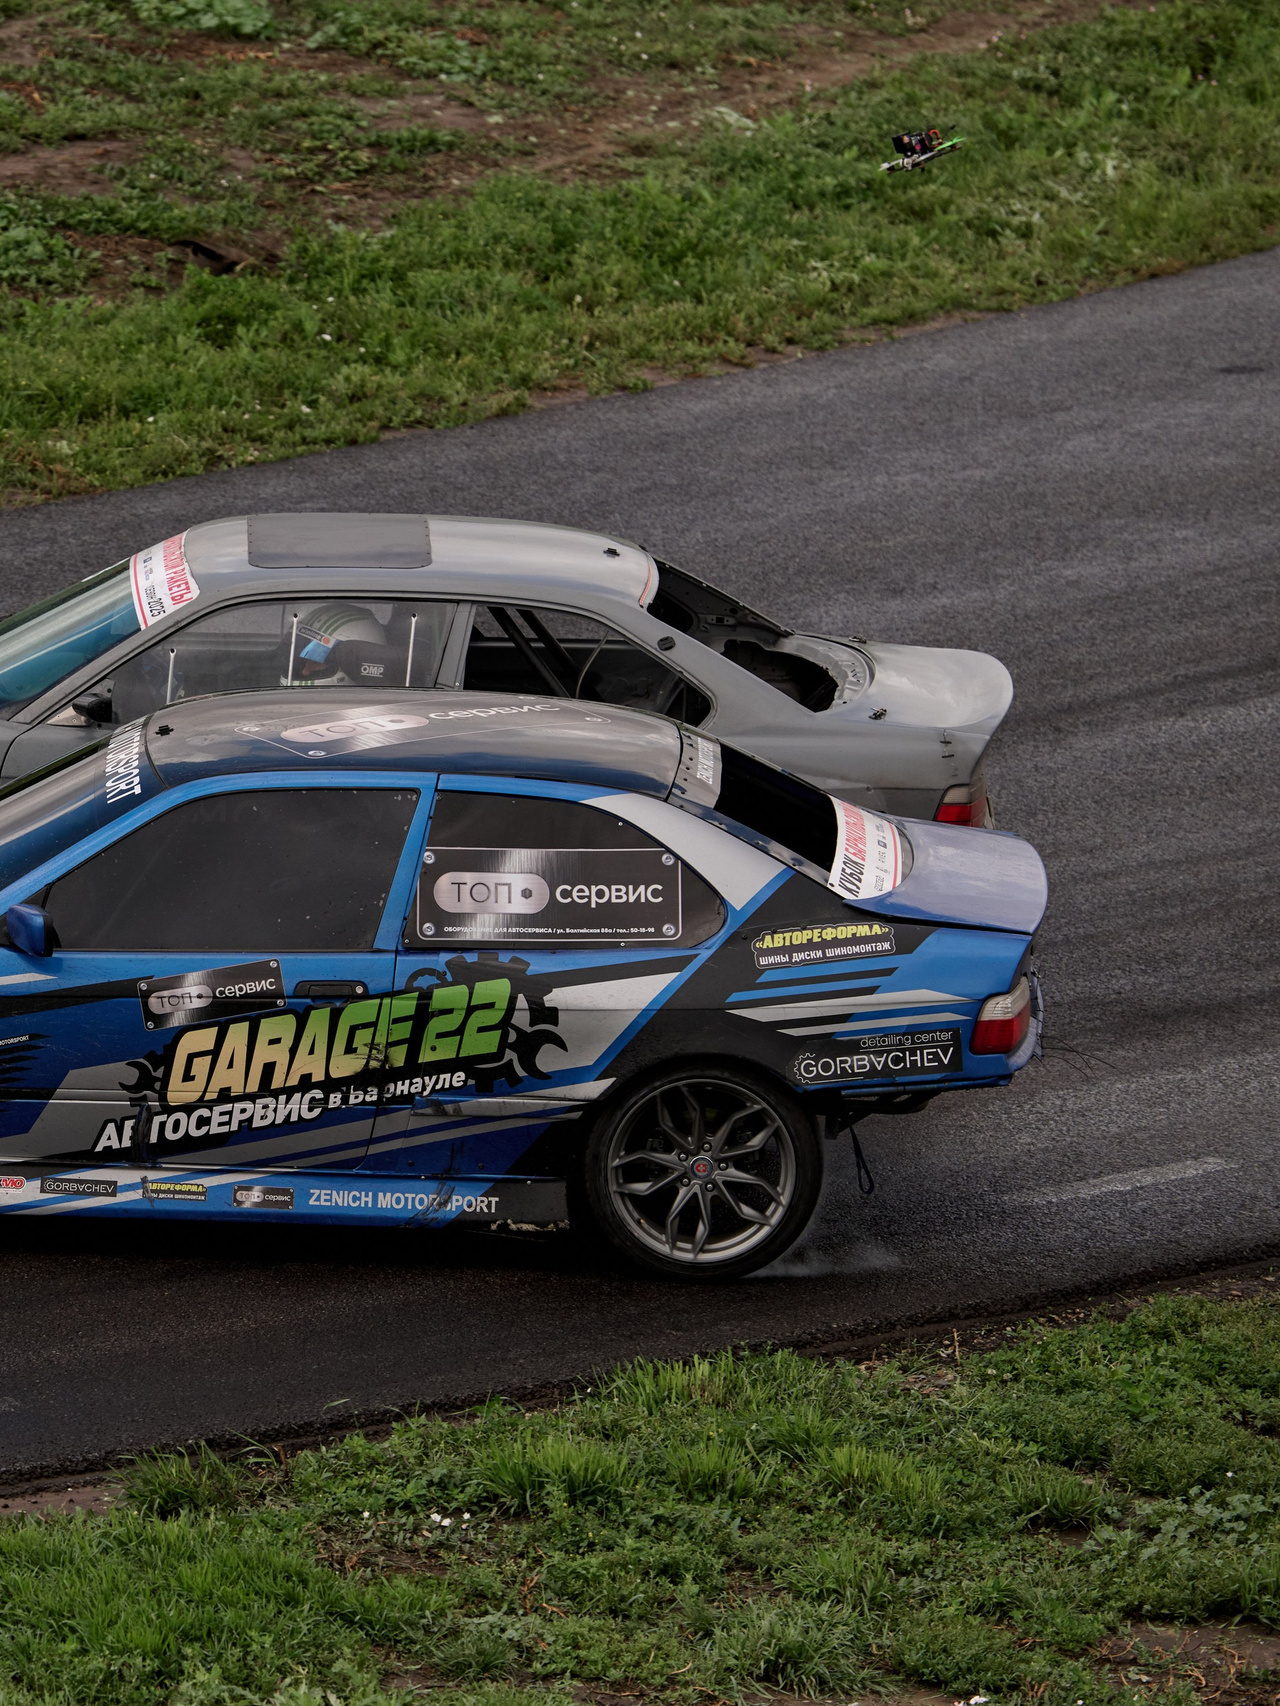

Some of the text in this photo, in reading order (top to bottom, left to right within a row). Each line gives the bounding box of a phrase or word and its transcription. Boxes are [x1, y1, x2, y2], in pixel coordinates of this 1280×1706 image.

[165, 567, 194, 606] РАКЕТЫ
[147, 597, 166, 618] 2025
[361, 665, 384, 675] OMP
[299, 704, 560, 737] ТОП сервис
[838, 853, 866, 898] КУБОК
[451, 882, 663, 908] ТОП сервис
[755, 924, 889, 949] «АВТОРЕФОРМА»
[156, 978, 276, 1008] ТОП сервис
[167, 978, 512, 1106] GARAGE 22
[860, 1031, 953, 1048] detailing center
[800, 1047, 954, 1078] GORBACHEV
[328, 1091, 342, 1108] в
[240, 1192, 256, 1200] ТОП
[308, 1189, 372, 1208] ZENICH
